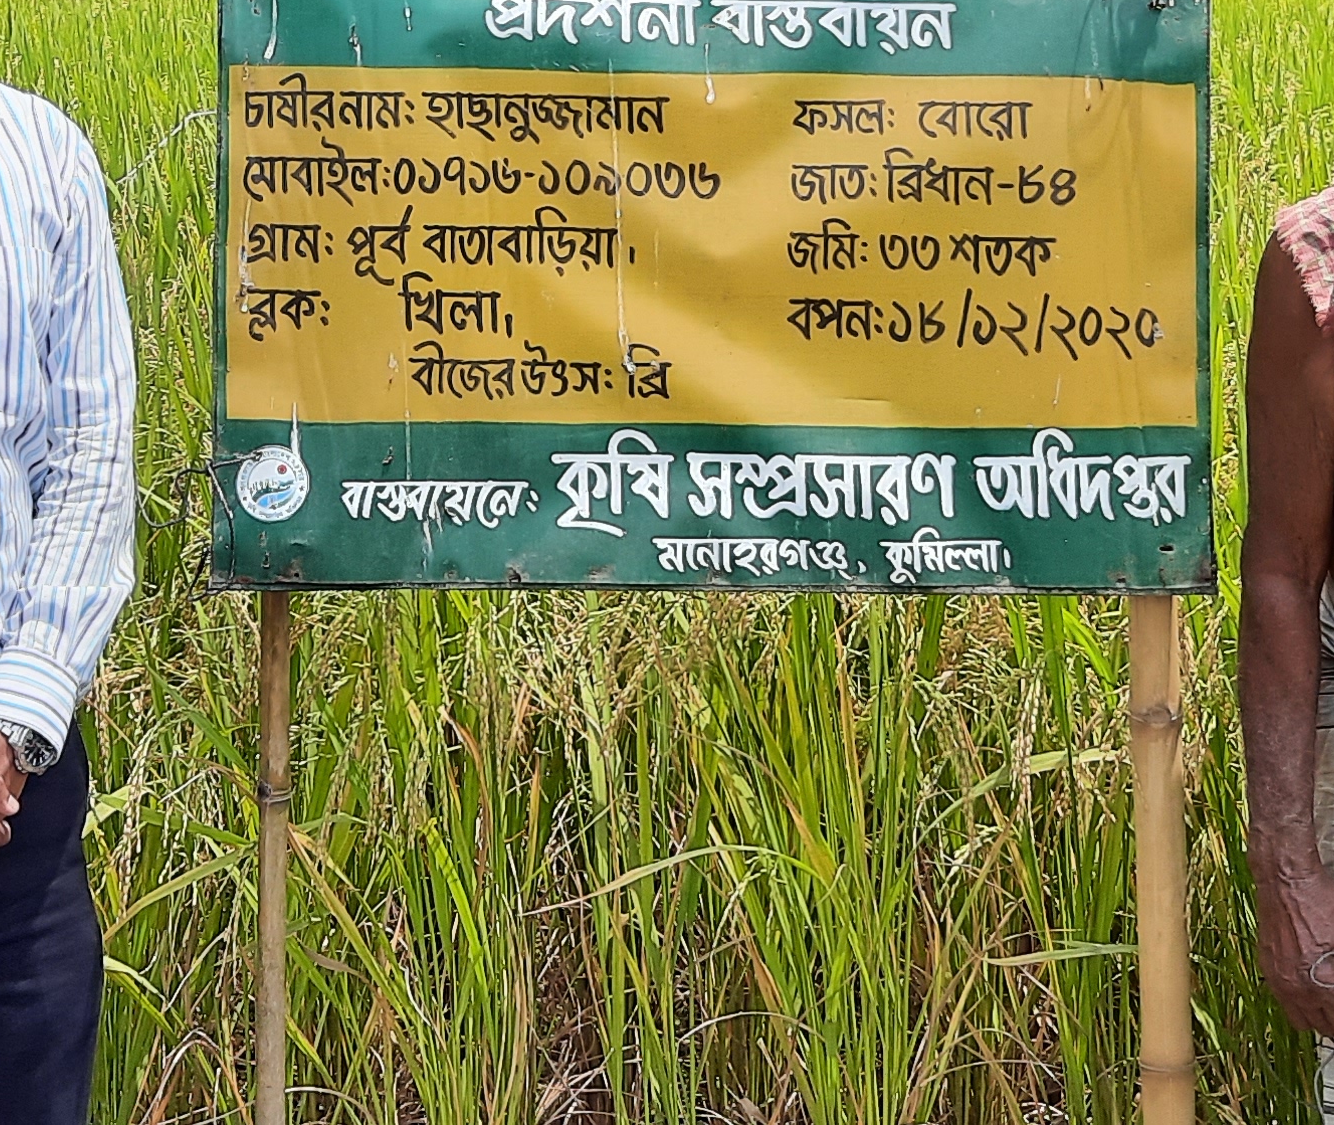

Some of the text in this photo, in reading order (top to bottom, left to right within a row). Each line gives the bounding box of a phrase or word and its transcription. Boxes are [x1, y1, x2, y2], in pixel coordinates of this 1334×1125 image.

[710, 0, 957, 55] বাস্তবায়ন
[423, 91, 669, 144] হাছানুজ্জামান
[792, 99, 1033, 141] ফসল: বোরো
[247, 223, 334, 263] গ্রাম:
[347, 204, 412, 286] পূর্ব
[786, 218, 1057, 276] জমি: ৩৩ শতক
[247, 288, 330, 341] ব্লক:
[623, 343, 673, 398] ব্রি
[551, 428, 675, 537] কৃষি
[687, 451, 956, 525] সম্প্রসারণ
[973, 427, 1193, 525] অধিদপ্তর
